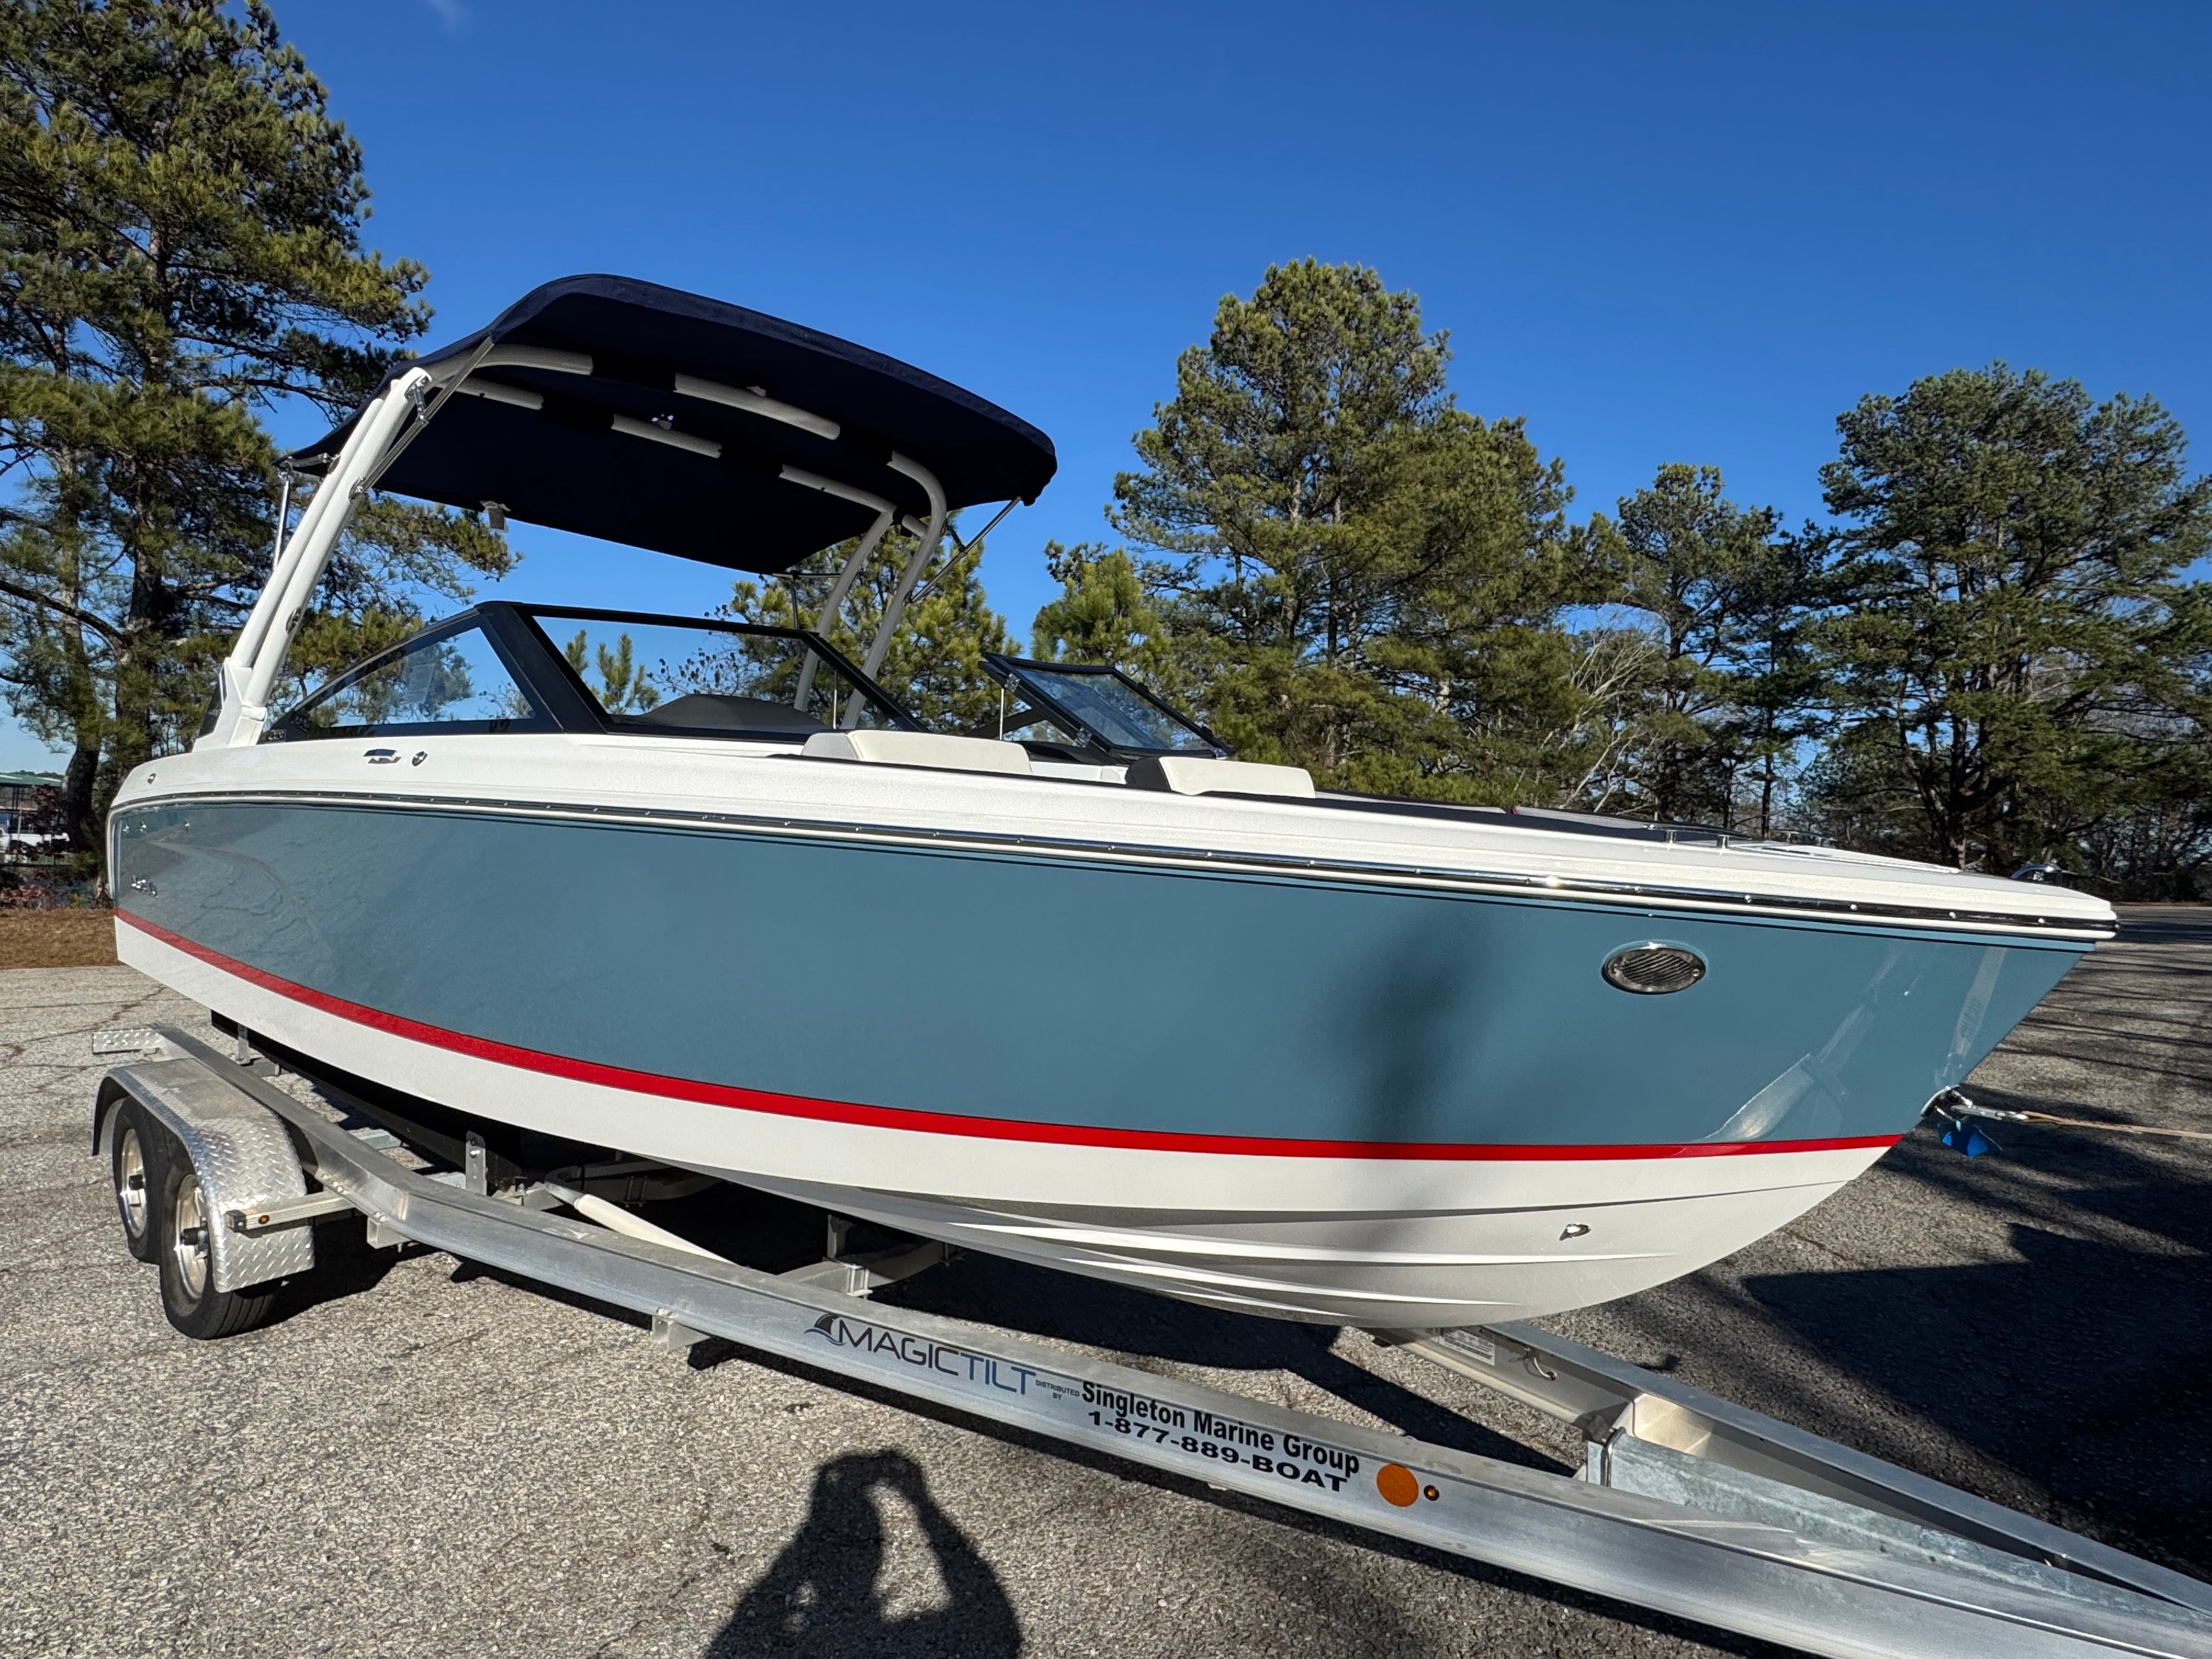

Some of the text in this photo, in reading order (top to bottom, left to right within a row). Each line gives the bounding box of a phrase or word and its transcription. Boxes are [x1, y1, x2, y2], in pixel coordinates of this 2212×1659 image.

[838, 1319, 1036, 1395] MAGICTILT
[1035, 1379, 1080, 1397] DISTRIBUTED
[1082, 1381, 1359, 1478] Singleton Marine Group
[1088, 1410, 1347, 1492] 1-877-889-BOAT
